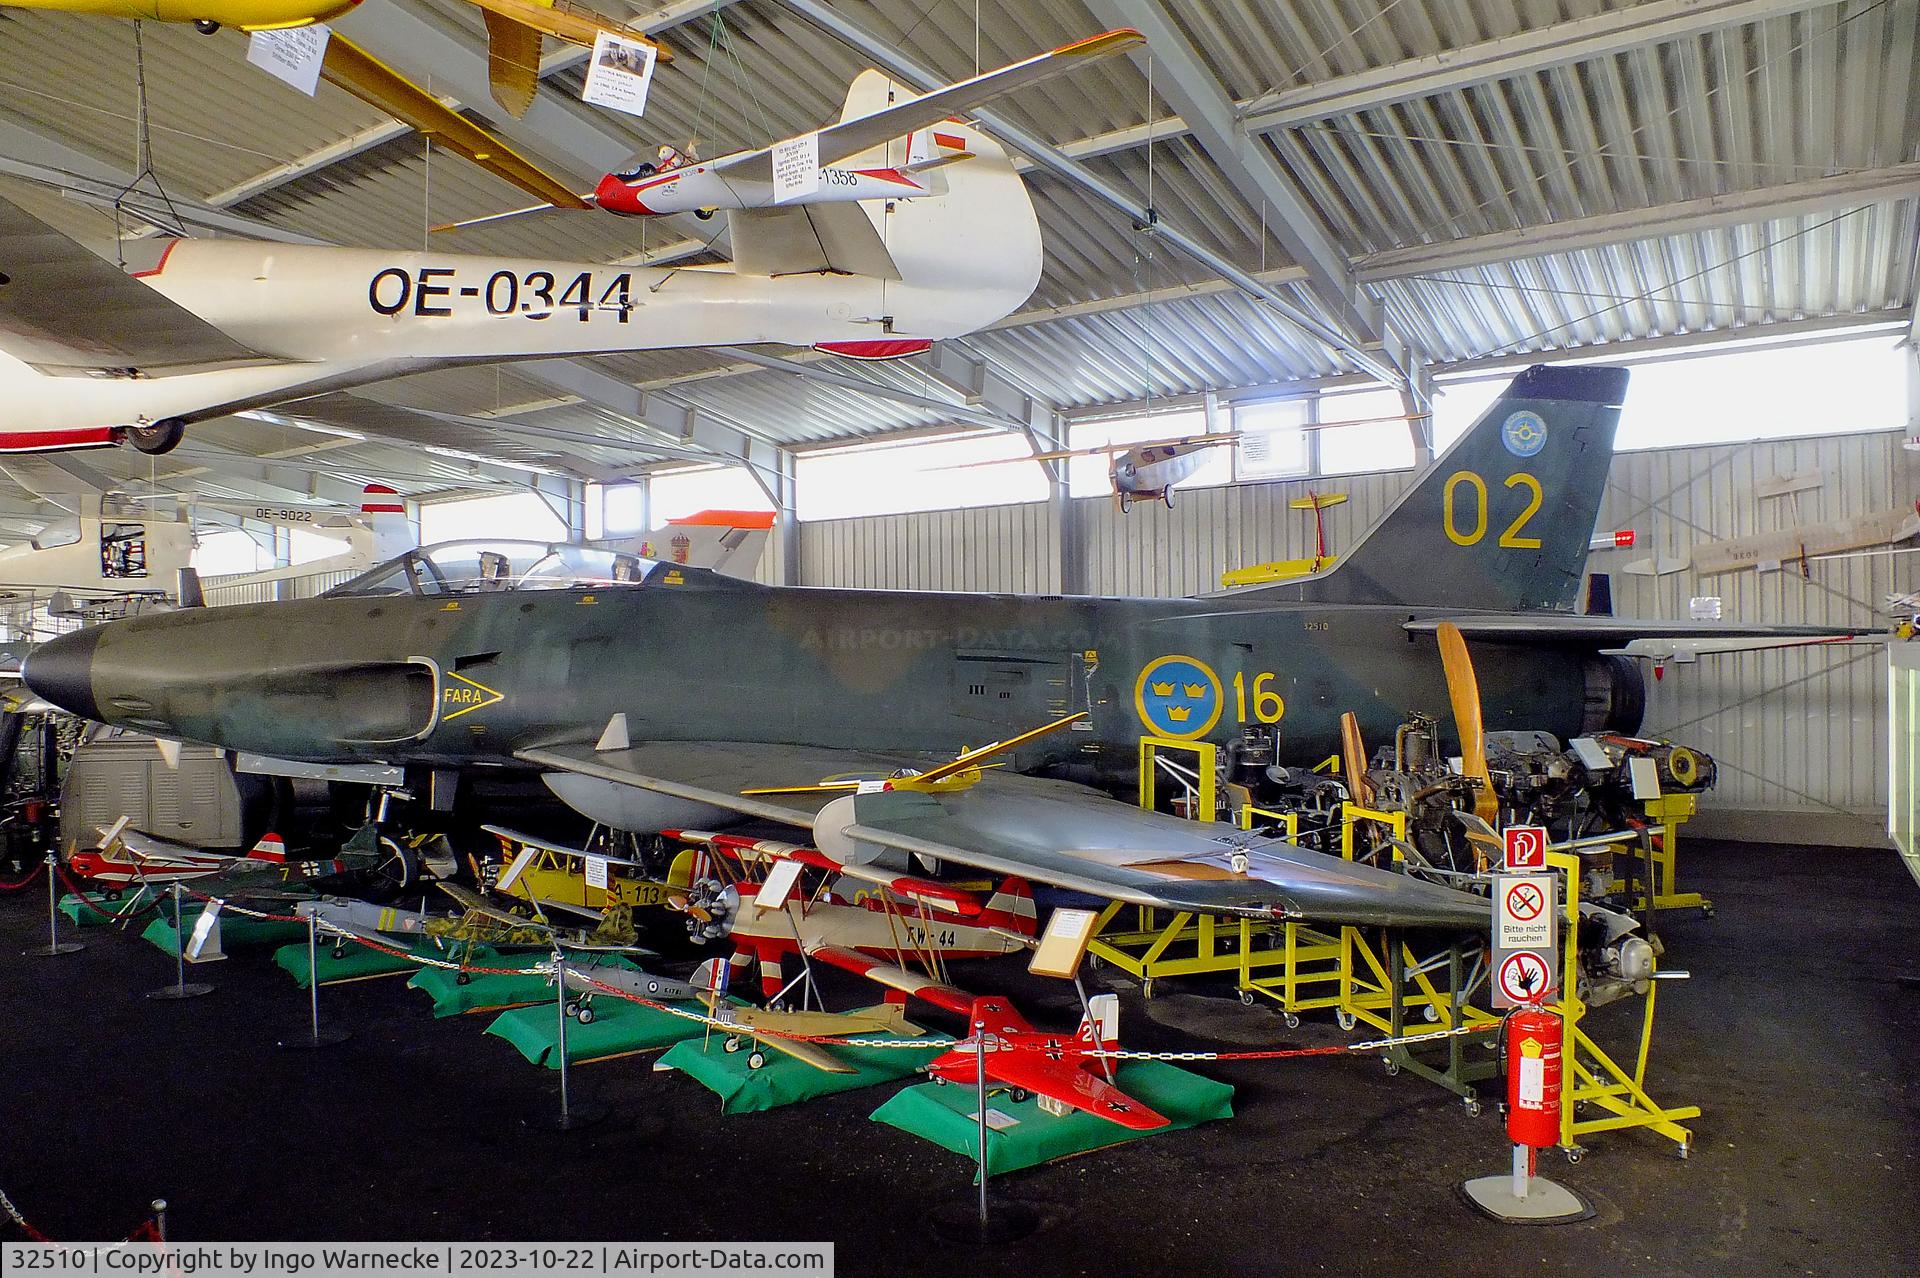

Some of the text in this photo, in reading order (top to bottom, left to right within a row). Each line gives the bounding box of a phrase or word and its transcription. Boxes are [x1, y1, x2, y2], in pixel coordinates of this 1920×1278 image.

[368, 267, 632, 324] OE-0344
[256, 508, 312, 522] OE-9022
[1443, 470, 1543, 549] 02
[444, 688, 483, 703] FARA
[1233, 671, 1285, 724] 16
[1504, 925, 1547, 933] Bitte nicht
